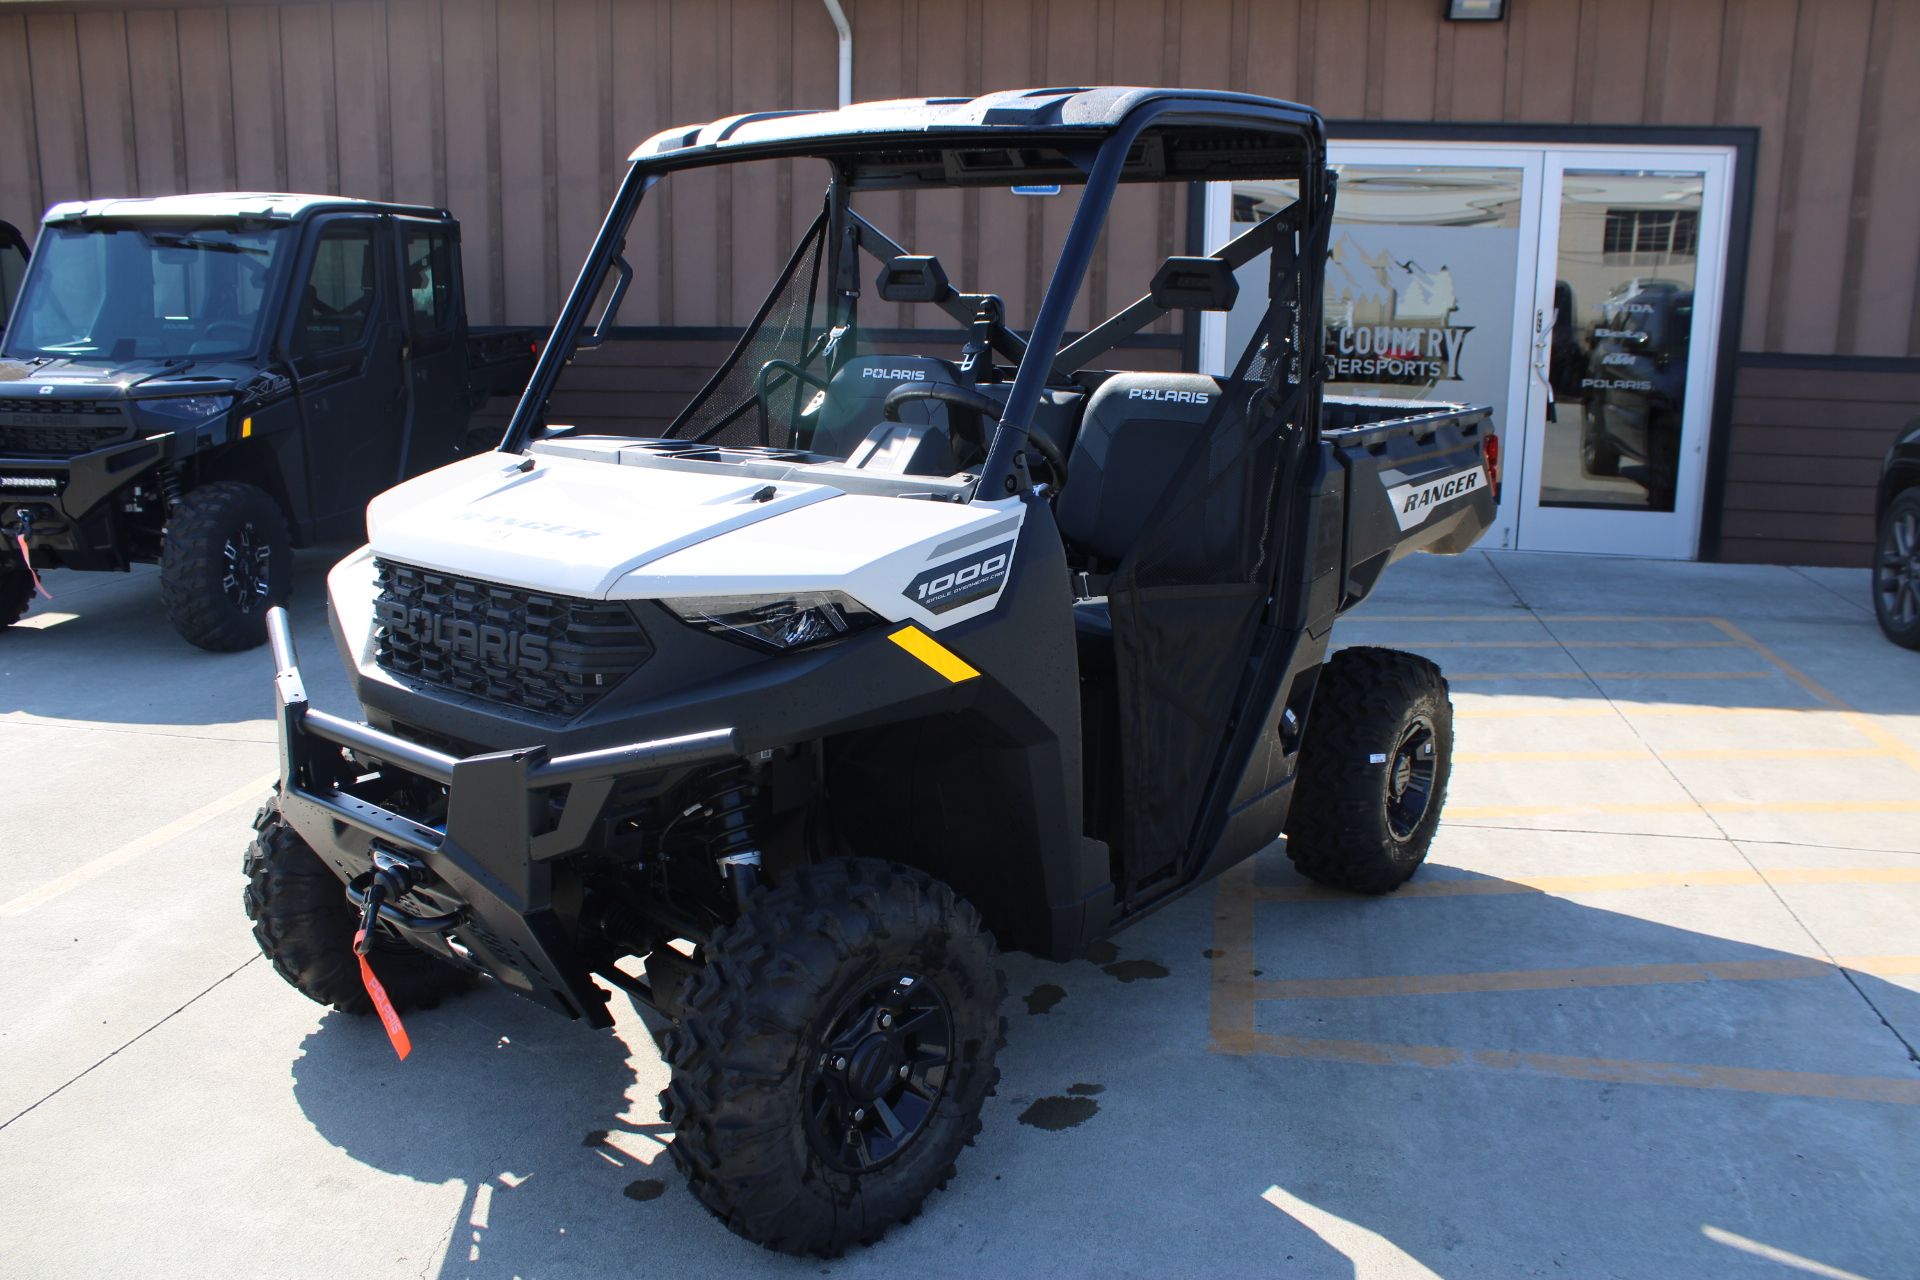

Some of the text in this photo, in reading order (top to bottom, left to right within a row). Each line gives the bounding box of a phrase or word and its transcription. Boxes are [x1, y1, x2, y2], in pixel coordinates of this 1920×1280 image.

[1335, 357, 1441, 377] ERSPORTS
[1339, 325, 1466, 378] COUNTRY
[862, 367, 925, 381] POLARIS
[1581, 378, 1652, 391] POLARIS
[1128, 387, 1210, 405] POLARIS
[1403, 471, 1477, 513] RANGER
[917, 553, 1007, 600] 1000
[387, 599, 549, 673] POLARIS
[369, 977, 402, 1035] POLARIS
